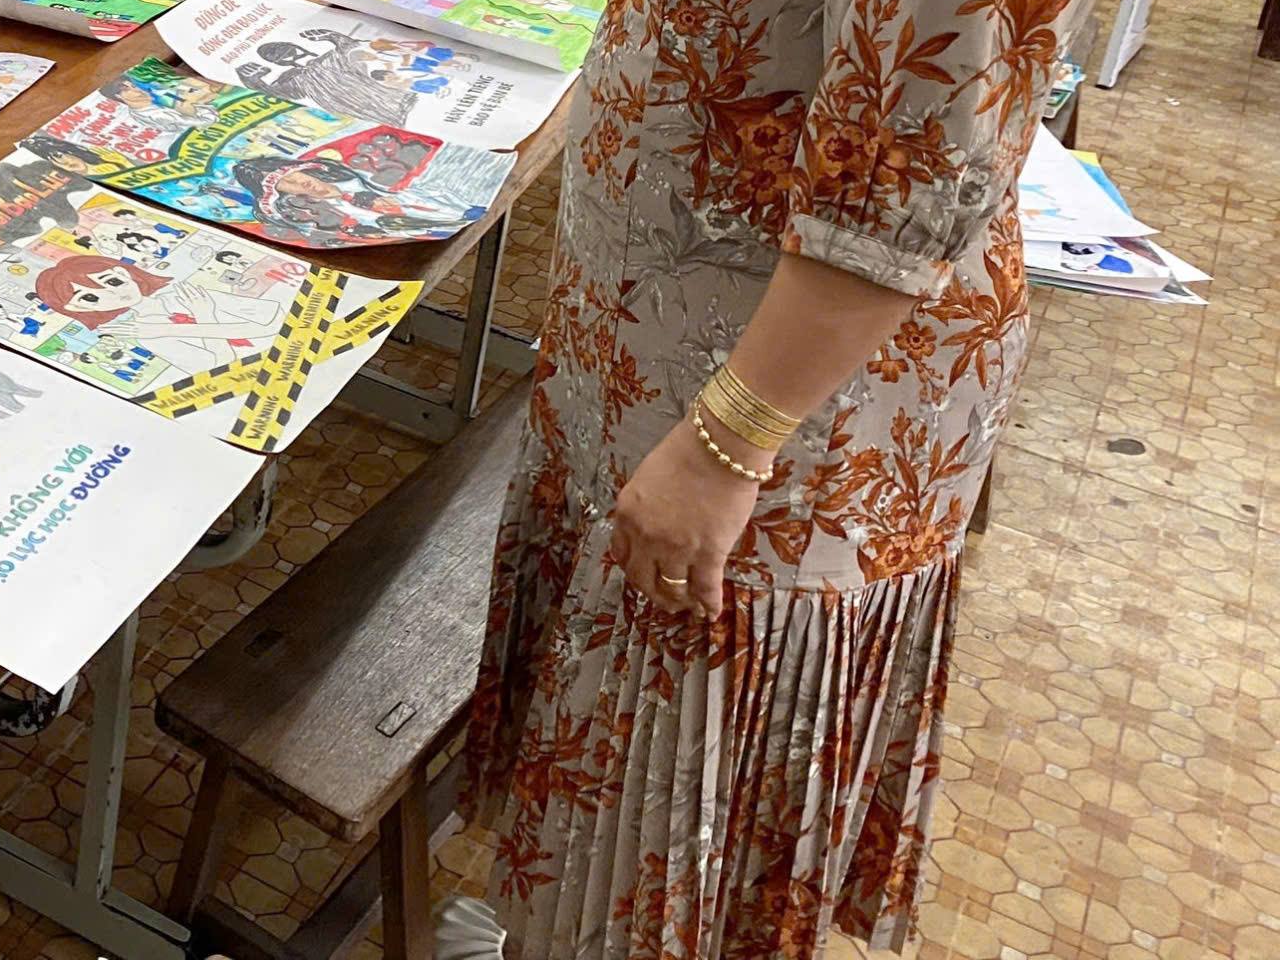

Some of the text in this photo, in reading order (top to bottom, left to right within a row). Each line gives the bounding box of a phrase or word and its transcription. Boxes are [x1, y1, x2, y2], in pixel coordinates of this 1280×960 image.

[38, 499, 77, 534] HỌC
[70, 444, 131, 501] ĐƯỜNG
[54, 444, 94, 474] VỚI
